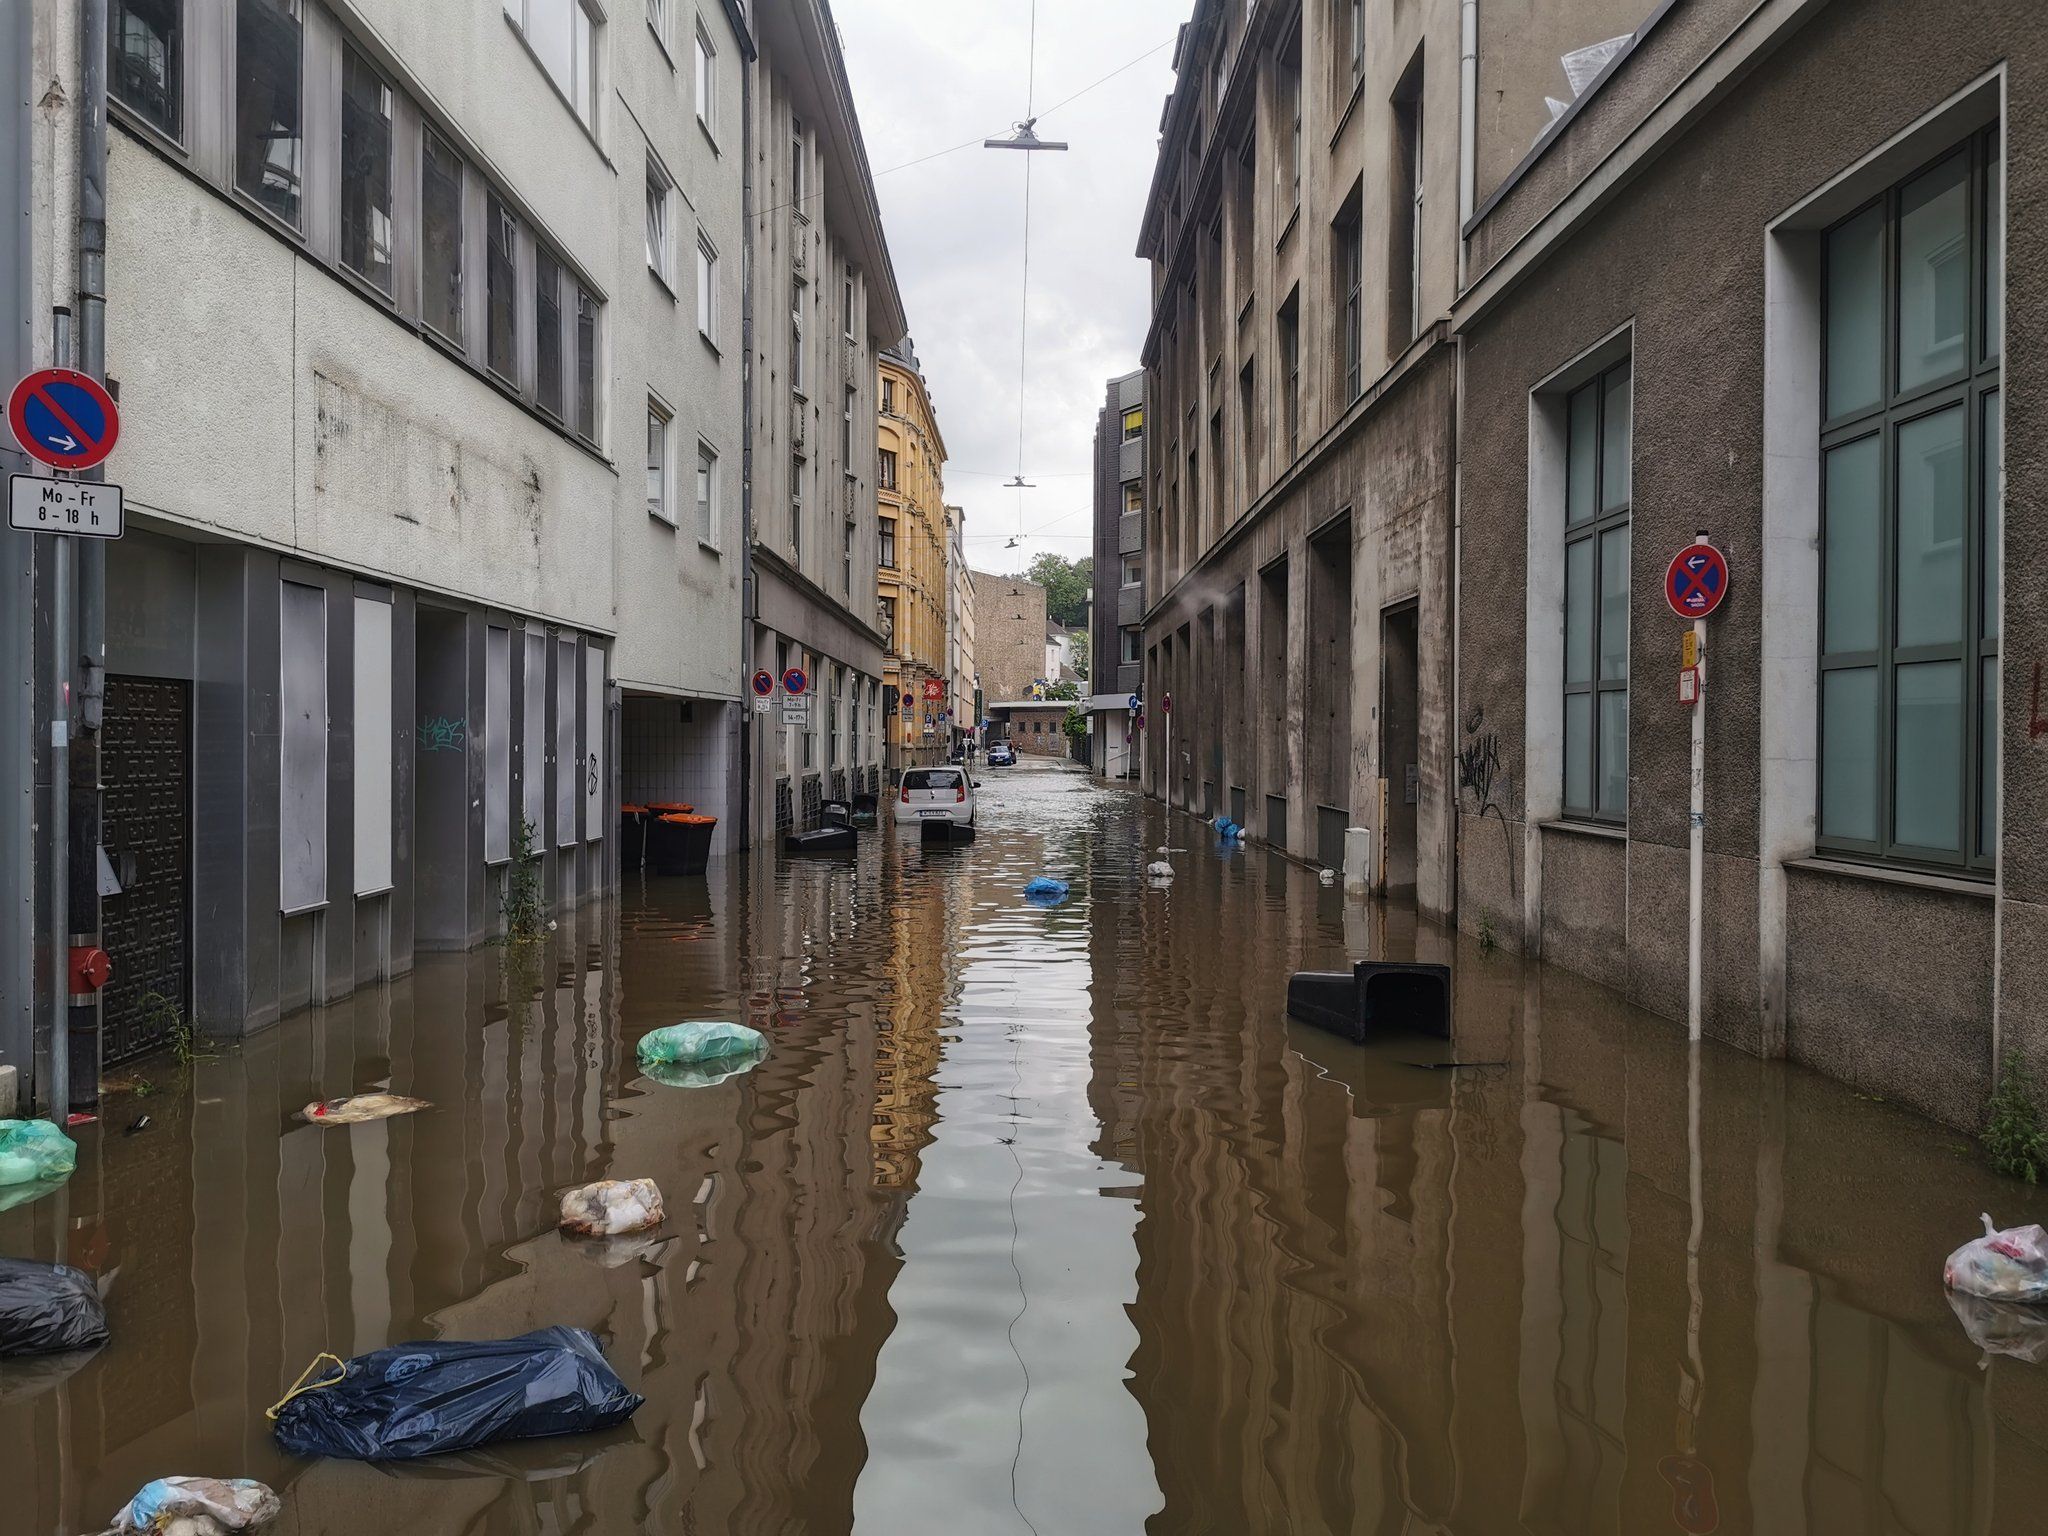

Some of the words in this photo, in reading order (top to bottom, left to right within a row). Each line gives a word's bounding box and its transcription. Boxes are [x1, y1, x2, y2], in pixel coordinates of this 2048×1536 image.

[43, 487, 62, 503] Mo
[81, 491, 95, 506] Fr
[39, 506, 46, 521] 8
[66, 508, 79, 524] 18
[91, 511, 99, 525] h
